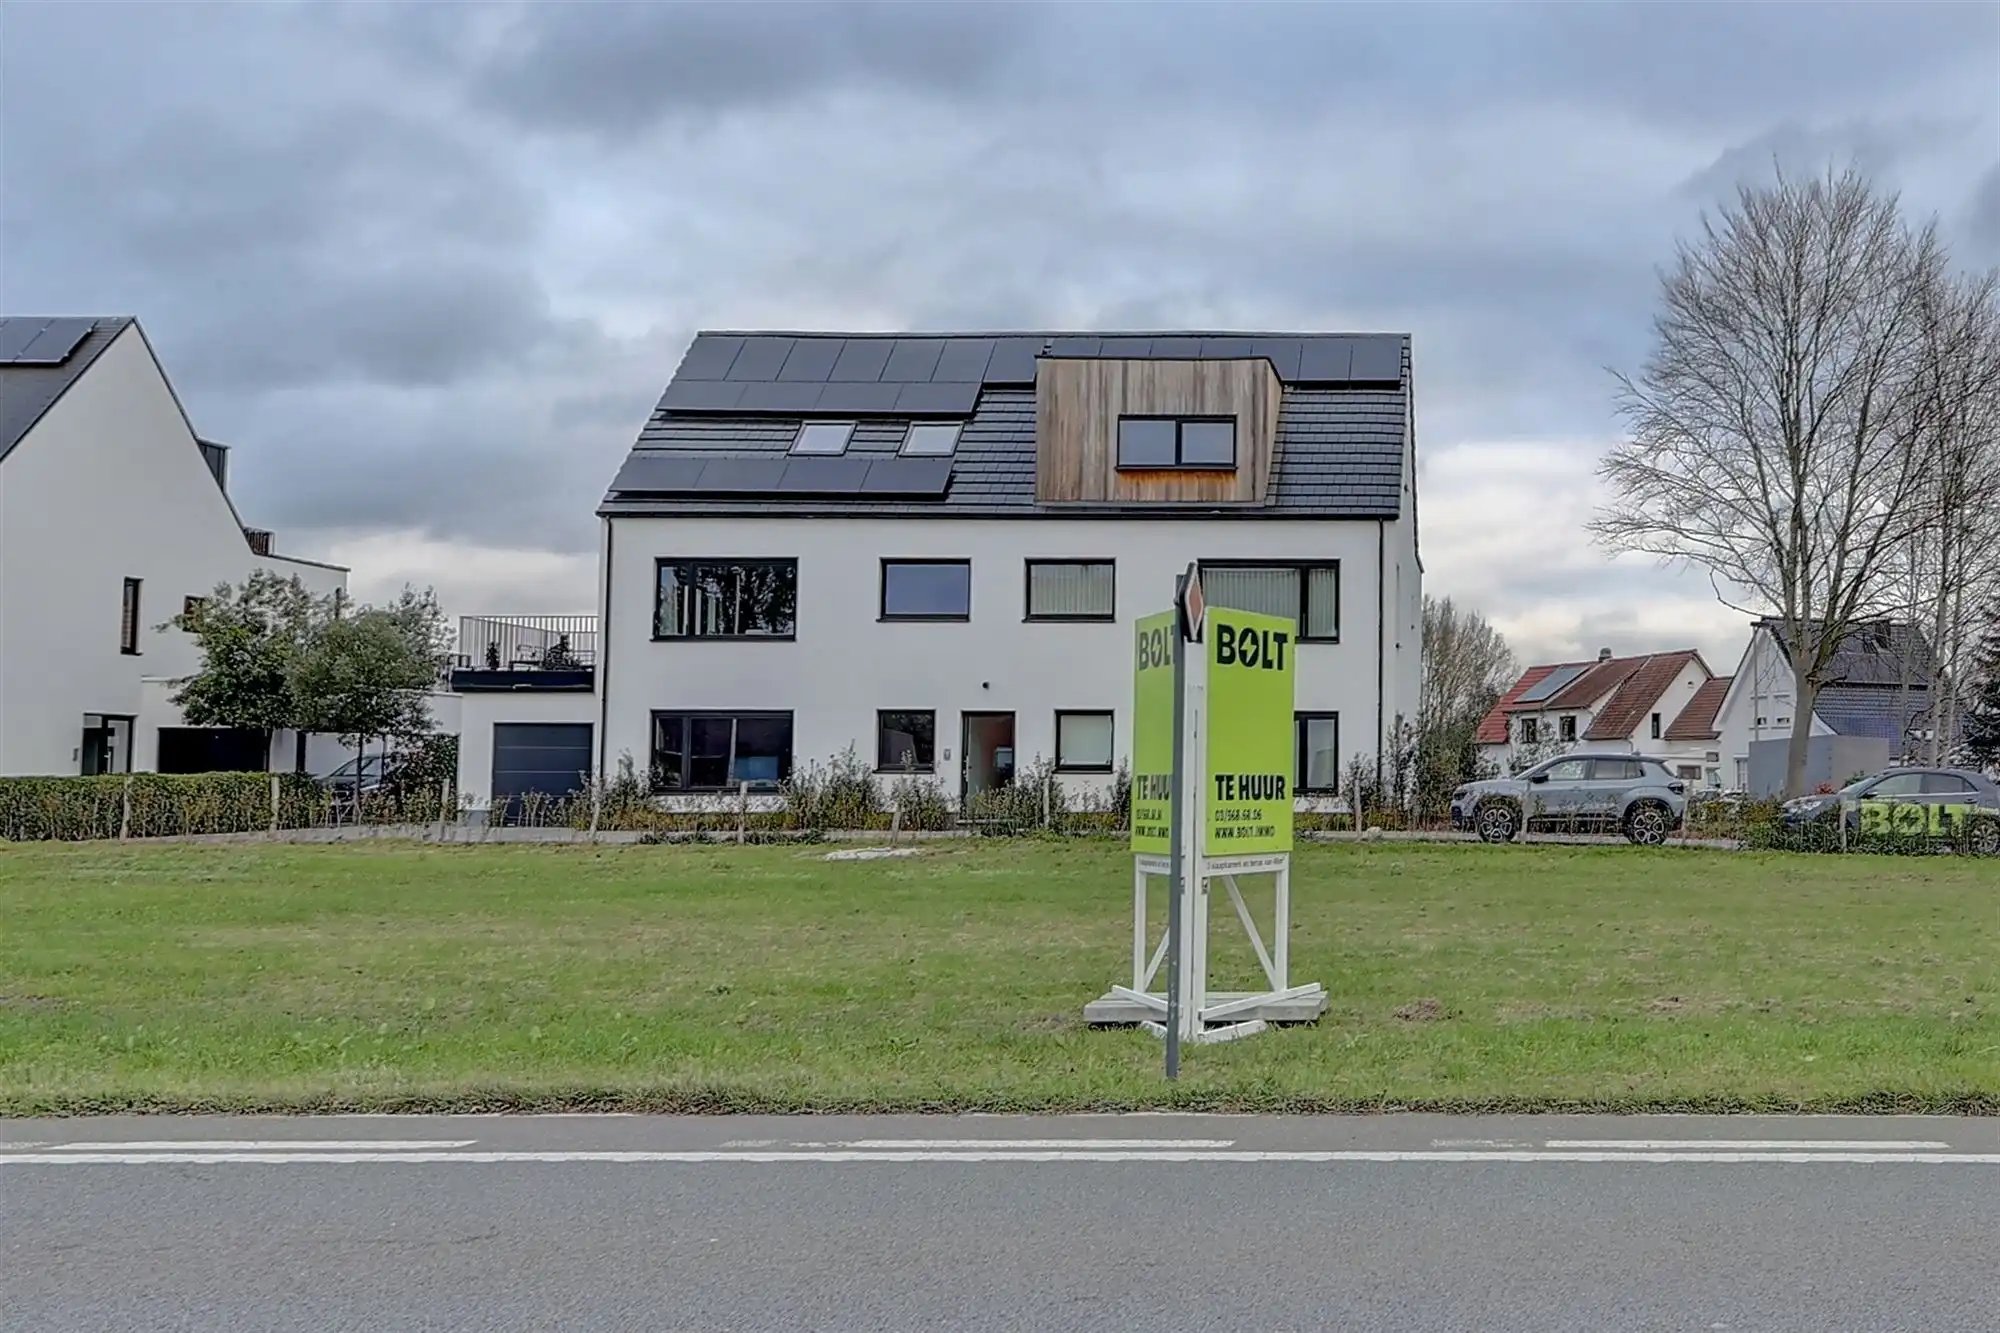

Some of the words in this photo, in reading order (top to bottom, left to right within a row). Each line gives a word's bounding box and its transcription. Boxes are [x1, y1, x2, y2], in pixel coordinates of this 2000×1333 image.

[1216, 623, 1288, 671] BOLT
[1137, 774, 1149, 800] TE
[1150, 774, 1172, 800] HUU
[1215, 774, 1236, 801] TE
[1238, 774, 1286, 801] HUUR
[1860, 802, 1971, 838] BOLT
